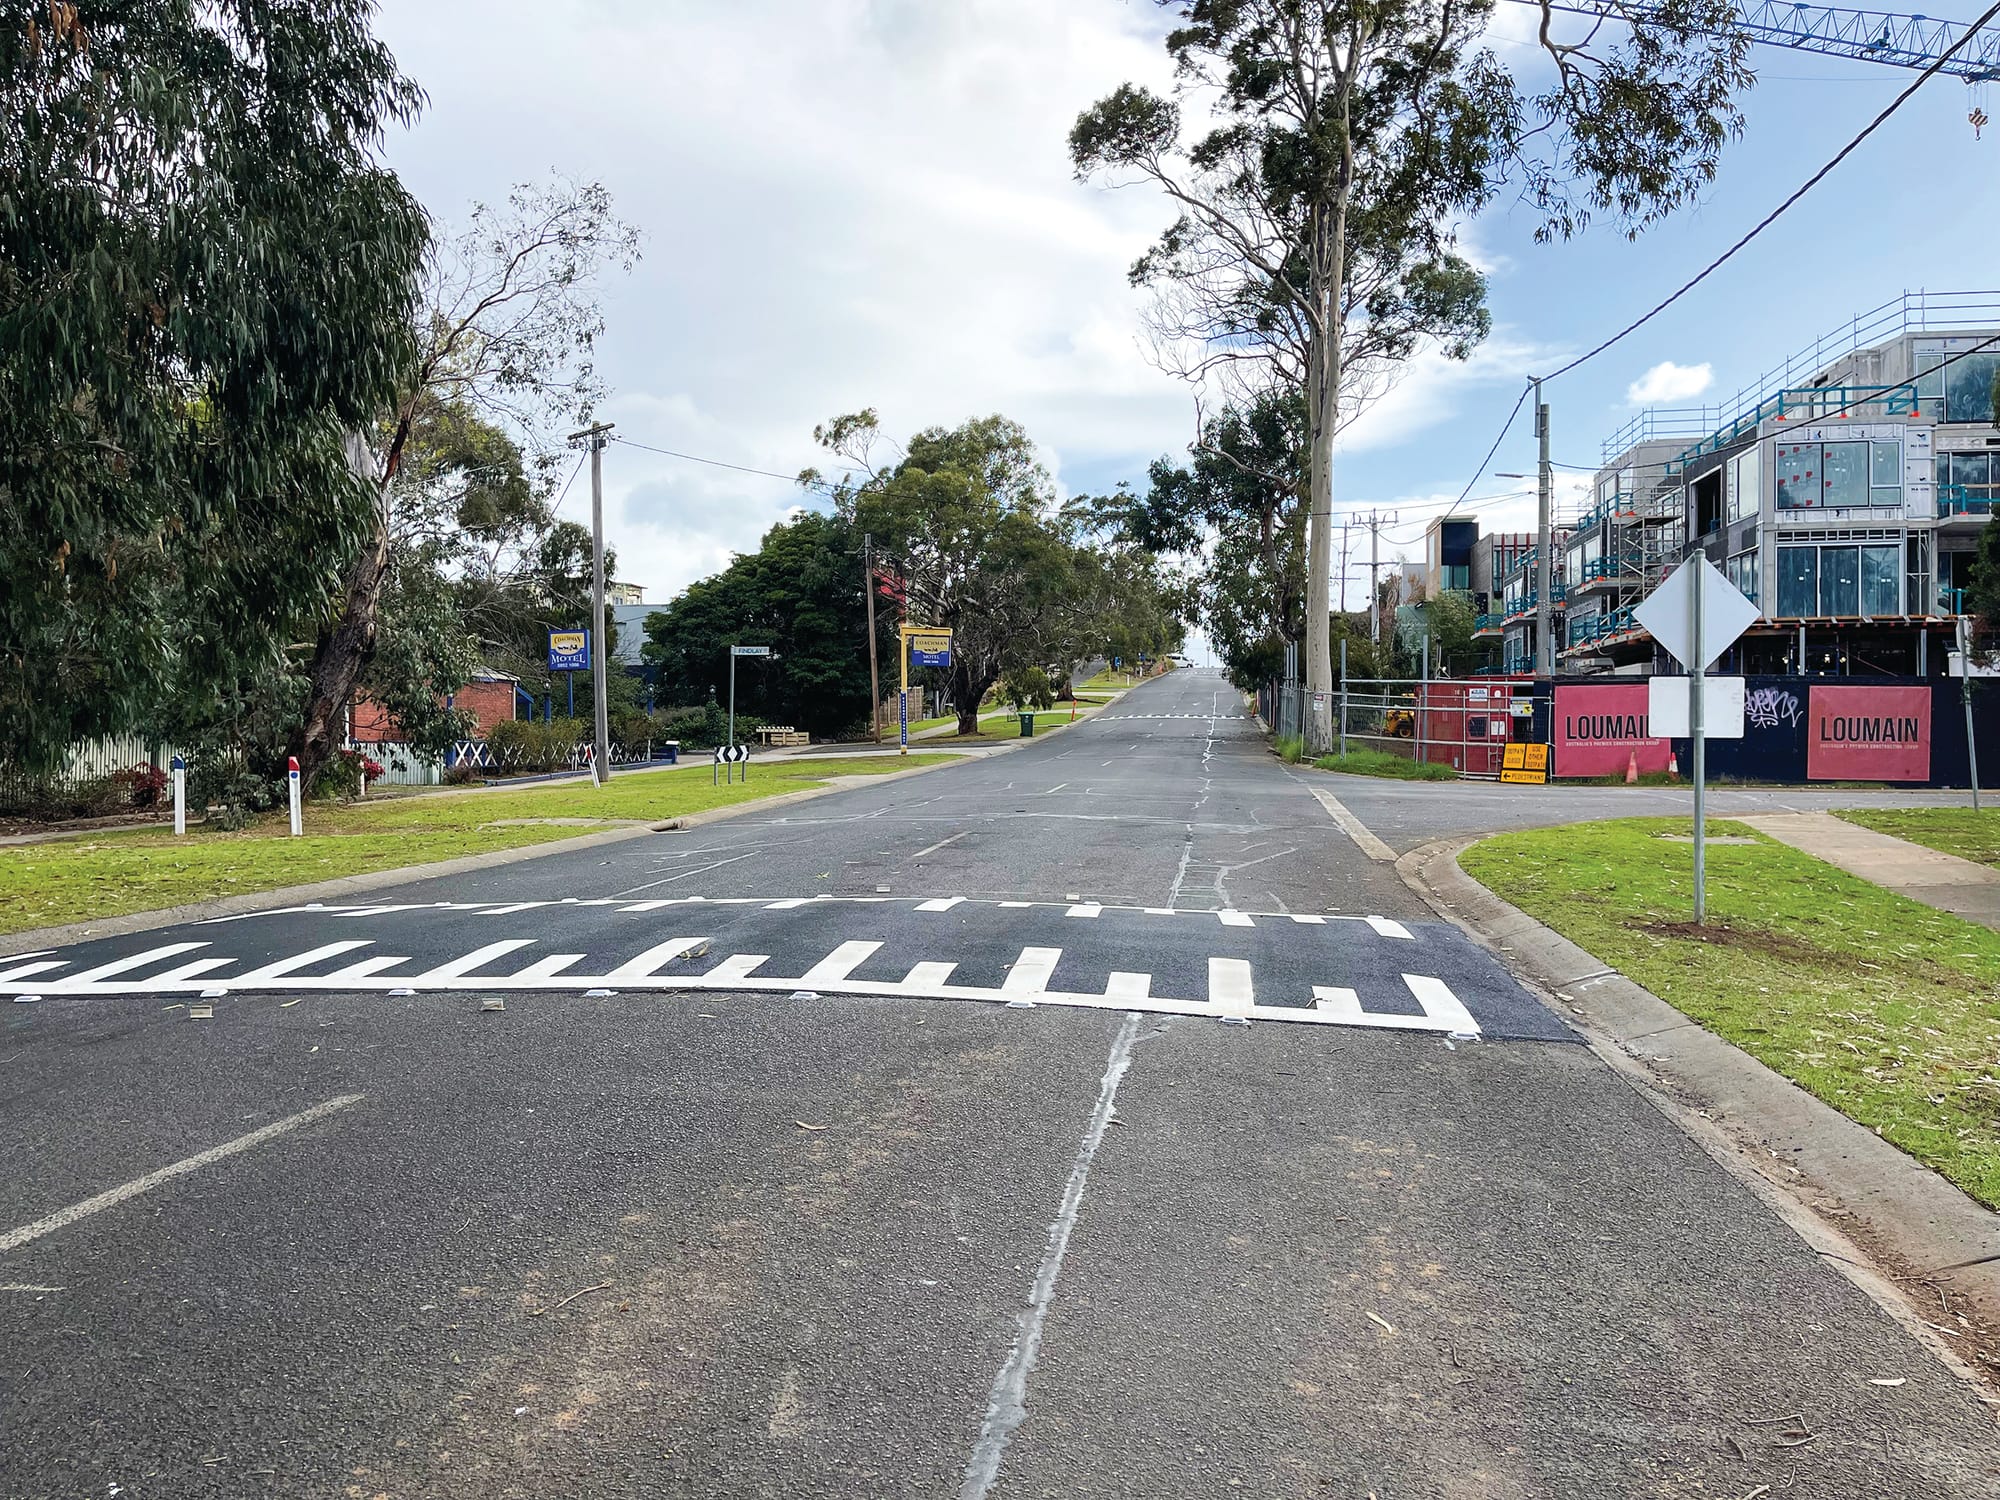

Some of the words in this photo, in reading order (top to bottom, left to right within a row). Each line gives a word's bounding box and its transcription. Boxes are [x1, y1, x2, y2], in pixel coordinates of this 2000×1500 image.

[551, 653, 586, 664] MOTEL
[1566, 715, 1650, 740] LOUMAI
[1821, 716, 1919, 742] LOUMAIN
[1511, 772, 1544, 781] PEDESTRIANS
